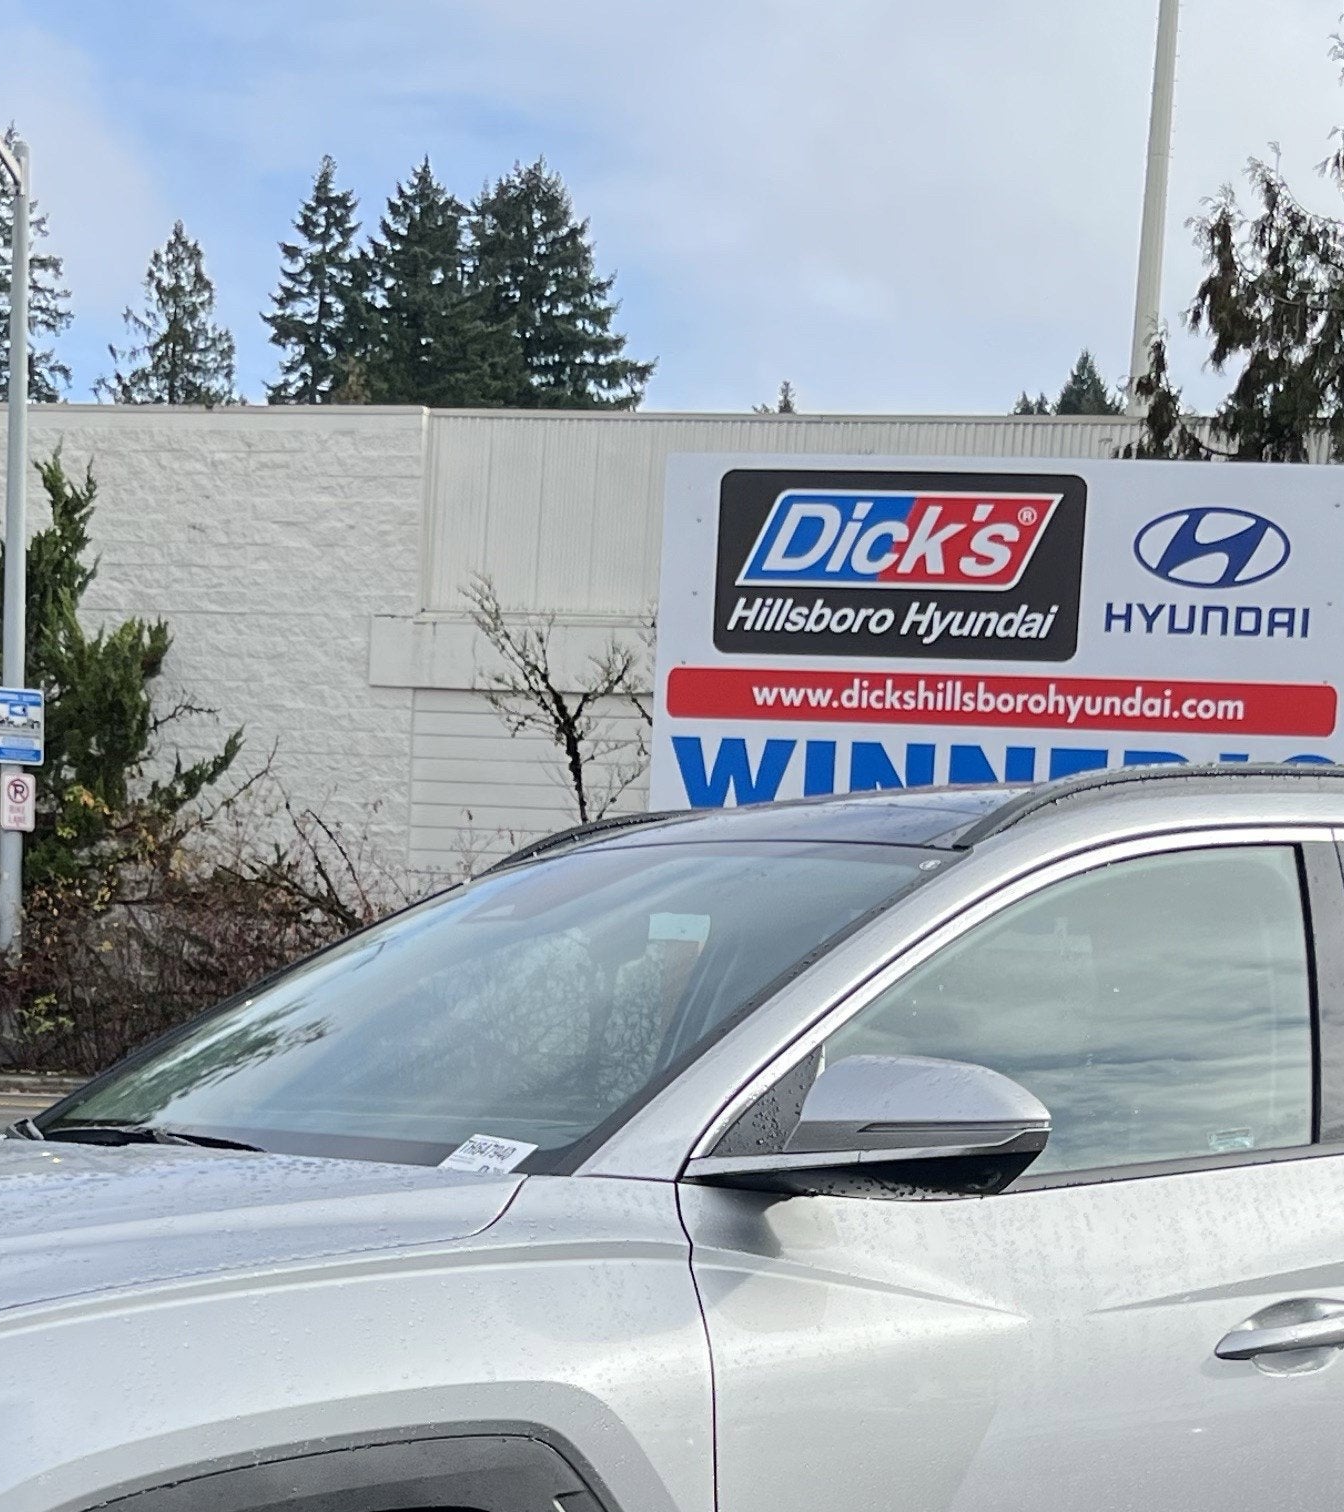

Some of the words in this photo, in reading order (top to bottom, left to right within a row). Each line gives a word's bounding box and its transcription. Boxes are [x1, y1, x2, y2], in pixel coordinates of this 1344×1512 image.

[761, 500, 1020, 578] Dick's
[726, 597, 895, 635] Hillsboro
[899, 601, 1059, 645] Hyundai
[1104, 602, 1310, 639] HYUNDAI
[752, 678, 1244, 724] www.dickshillsborohyundai.com
